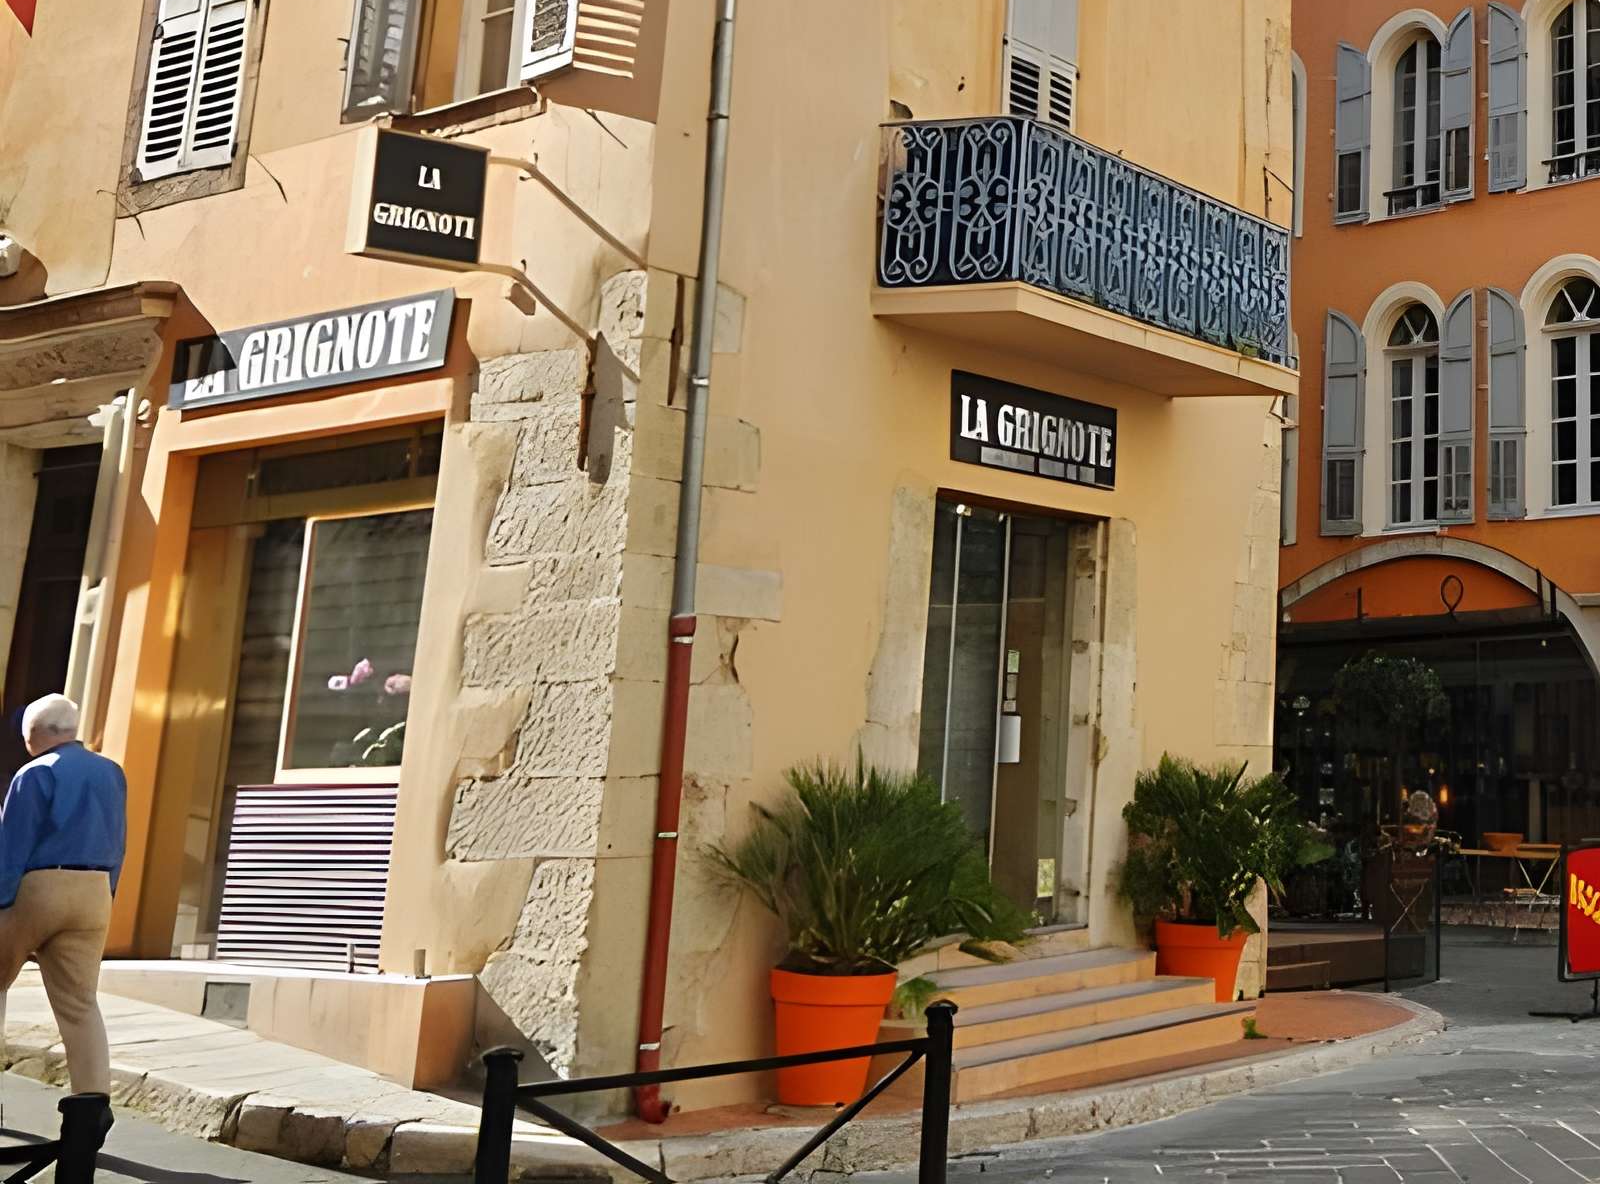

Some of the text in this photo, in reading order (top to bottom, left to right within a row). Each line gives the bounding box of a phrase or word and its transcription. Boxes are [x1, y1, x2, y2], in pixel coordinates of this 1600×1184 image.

[418, 165, 441, 190] LA
[237, 299, 437, 391] GRIGNOTE
[960, 394, 989, 442] LA
[997, 404, 1112, 468] GRIGNOTE
